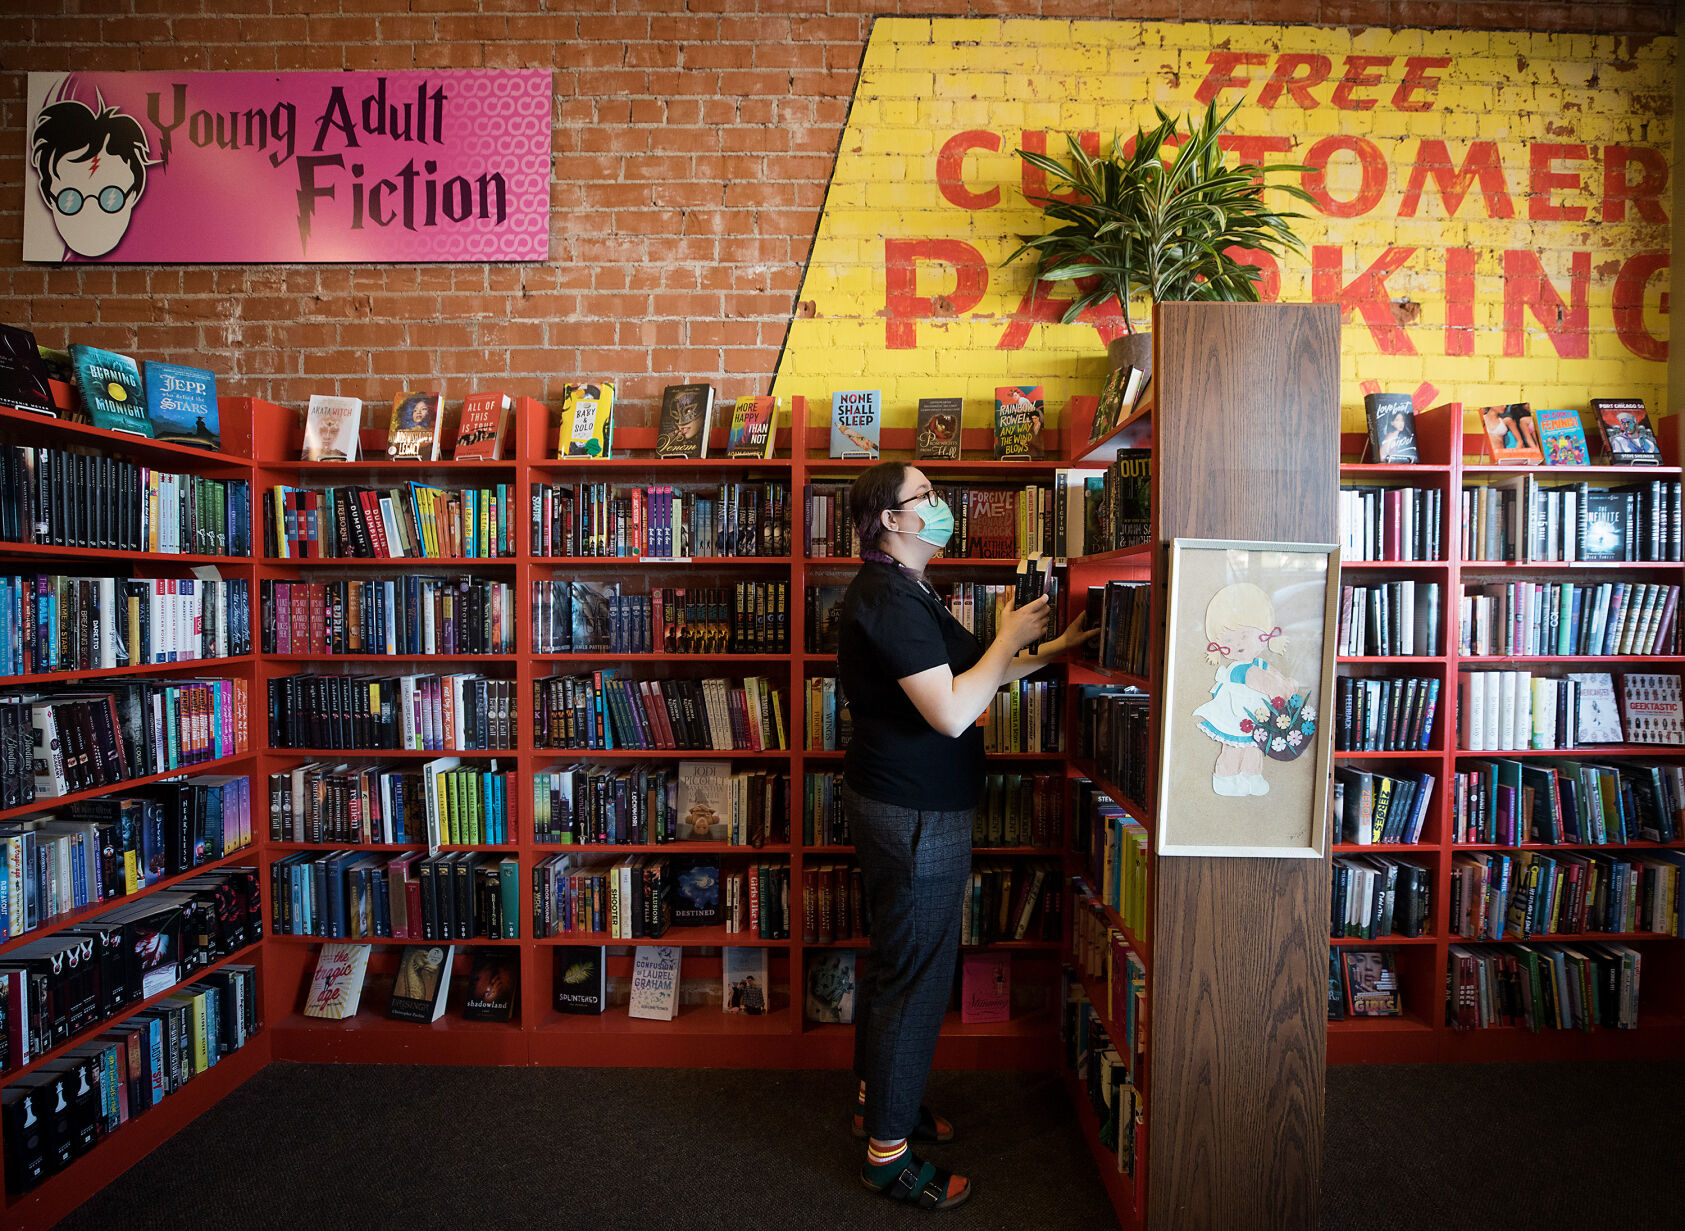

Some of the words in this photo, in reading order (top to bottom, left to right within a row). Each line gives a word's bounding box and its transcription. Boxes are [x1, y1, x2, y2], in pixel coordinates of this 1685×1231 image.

[1201, 51, 1452, 112] FREE
[146, 84, 297, 174] Young
[313, 78, 449, 151] Adult
[294, 155, 507, 257] Fiction
[90, 365, 137, 387] BURNING
[160, 397, 208, 414] STARS
[840, 393, 873, 404] NONE
[95, 397, 145, 419] MIDNIGHT
[311, 406, 331, 416] AKATA
[331, 406, 352, 417] WITCH
[467, 401, 481, 412] ALL
[485, 400, 495, 410] OF
[576, 408, 596, 418] BABY
[736, 402, 758, 413] MORE
[838, 405, 875, 416] SHALL
[999, 404, 1036, 416] RAINBOW
[470, 412, 488, 422] THIS
[734, 413, 759, 423] HAPPY
[839, 416, 874, 427] SLEEP
[1000, 414, 1031, 427] ROWELL
[462, 423, 470, 433] IS
[473, 423, 495, 432] TRUE
[574, 423, 594, 433] SOLO
[749, 424, 768, 433] THAN
[1000, 427, 1016, 437] ANY
[1017, 423, 1033, 434] WAY
[656, 433, 697, 453] Venom
[751, 434, 767, 444] NOT
[1001, 437, 1017, 448] THE
[1018, 433, 1033, 444] WIND
[1005, 444, 1029, 455] BLOWS
[969, 490, 1014, 508] FORGIVE
[338, 500, 347, 541] FIREBORNE
[738, 510, 746, 524] FANG
[351, 505, 366, 552] DUMPLIN'
[364, 509, 380, 552] DUMPLIN'
[372, 508, 388, 551] DUMPLIN'
[969, 525, 1013, 537] PEACOCK
[970, 536, 1014, 550] MATTHEW
[984, 547, 1014, 560] QUICK
[39, 577, 47, 594] THE
[39, 597, 47, 625] MALL
[333, 605, 342, 633] BURN
[1344, 694, 1352, 729] FEEDBACK
[1630, 703, 1678, 712] GEEKTASTIC
[824, 712, 832, 741] WINGS
[8, 737, 18, 775] Bloodlines
[24, 734, 33, 771] Bloodlines
[692, 766, 717, 776] JODI
[683, 776, 730, 786] PICOULT
[350, 789, 360, 829] requiem
[578, 784, 586, 821] Ascendant
[1362, 790, 1370, 825] ZEROES
[312, 780, 320, 843] pandemonium
[750, 877, 758, 898] Girls
[676, 909, 715, 917] DESTINED
[750, 899, 758, 916] Like
[807, 887, 815, 930] ALLEGIANT
[821, 887, 829, 930] ALLEGIANT
[750, 918, 758, 930] Us
[334, 951, 350, 962] the
[636, 961, 674, 970] CONFUSION
[315, 963, 352, 986] tragic
[643, 970, 672, 980] LAUREL
[634, 978, 671, 990] GRAHAM
[318, 989, 340, 1010] age
[467, 1001, 507, 1009] shadowland
[559, 993, 598, 1004] SPLINTERED
[1354, 1000, 1394, 1012] GIRLS
[152, 1042, 160, 1060] LADY
[152, 1070, 162, 1090] SPY
